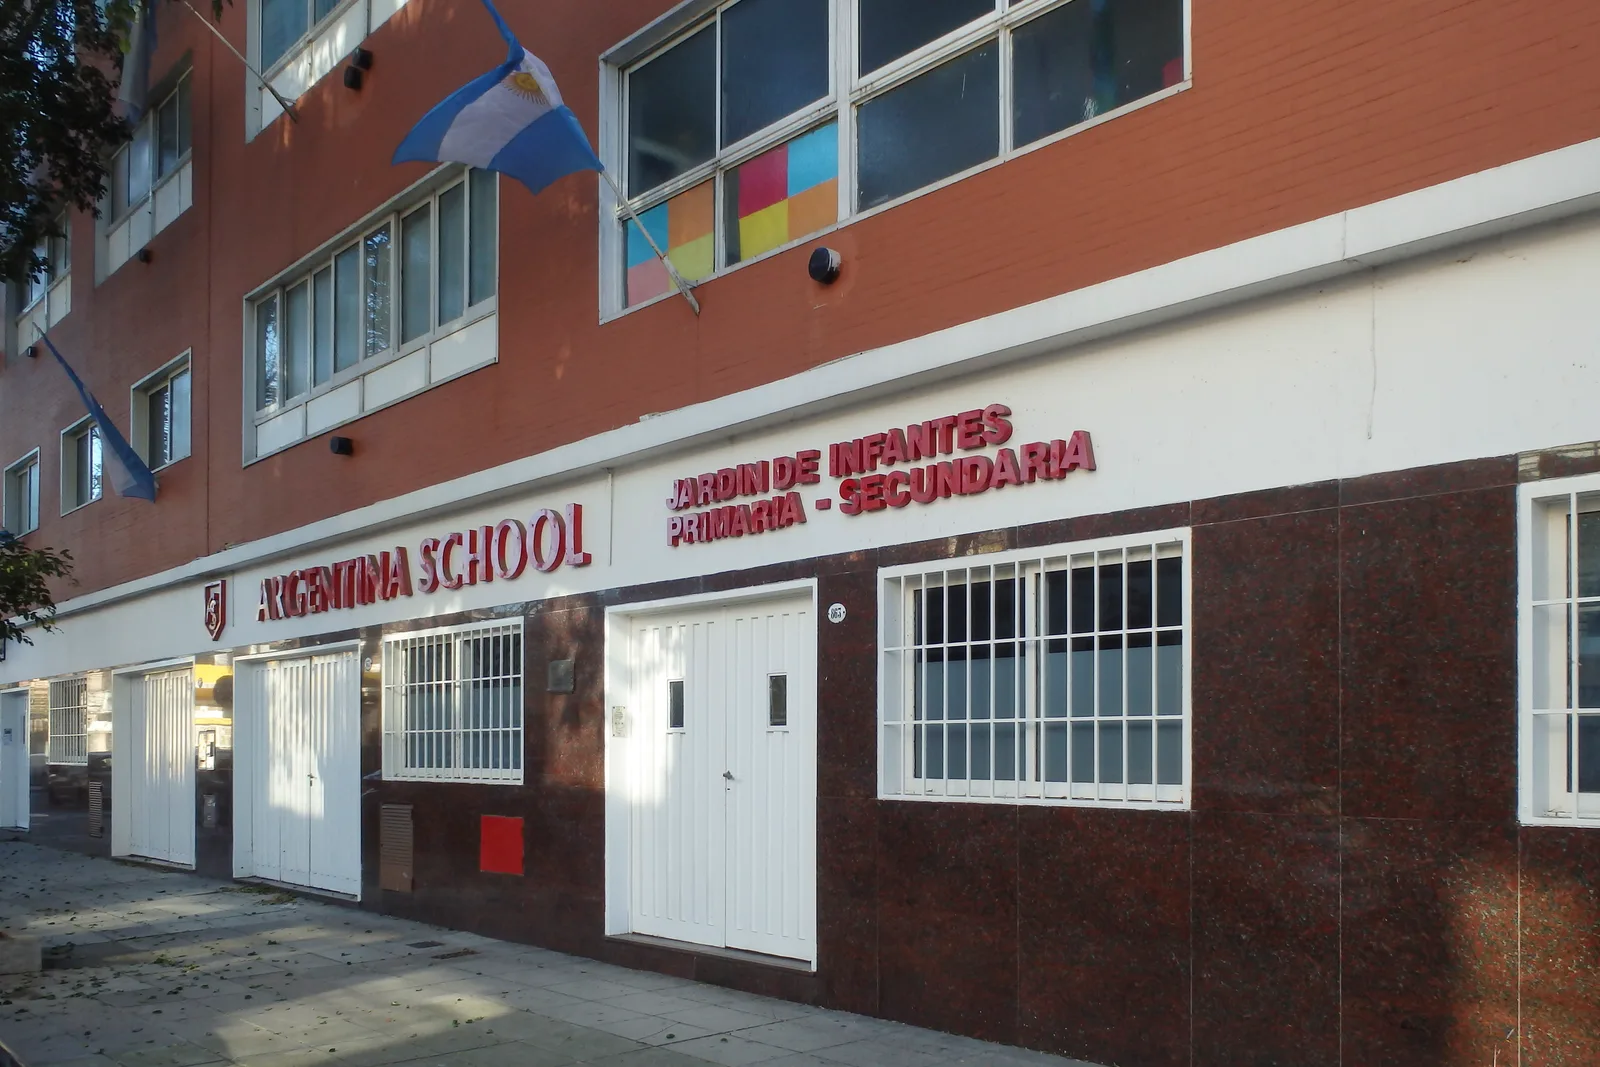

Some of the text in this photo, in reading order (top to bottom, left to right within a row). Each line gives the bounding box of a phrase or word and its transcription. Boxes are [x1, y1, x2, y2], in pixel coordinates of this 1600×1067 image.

[666, 403, 1013, 511] JARDIN DE INFANTES
[666, 491, 807, 547] PRIMARIA
[839, 430, 1097, 516] SECUNDARIA
[256, 503, 592, 622] ARGENTINA SCHOOL
